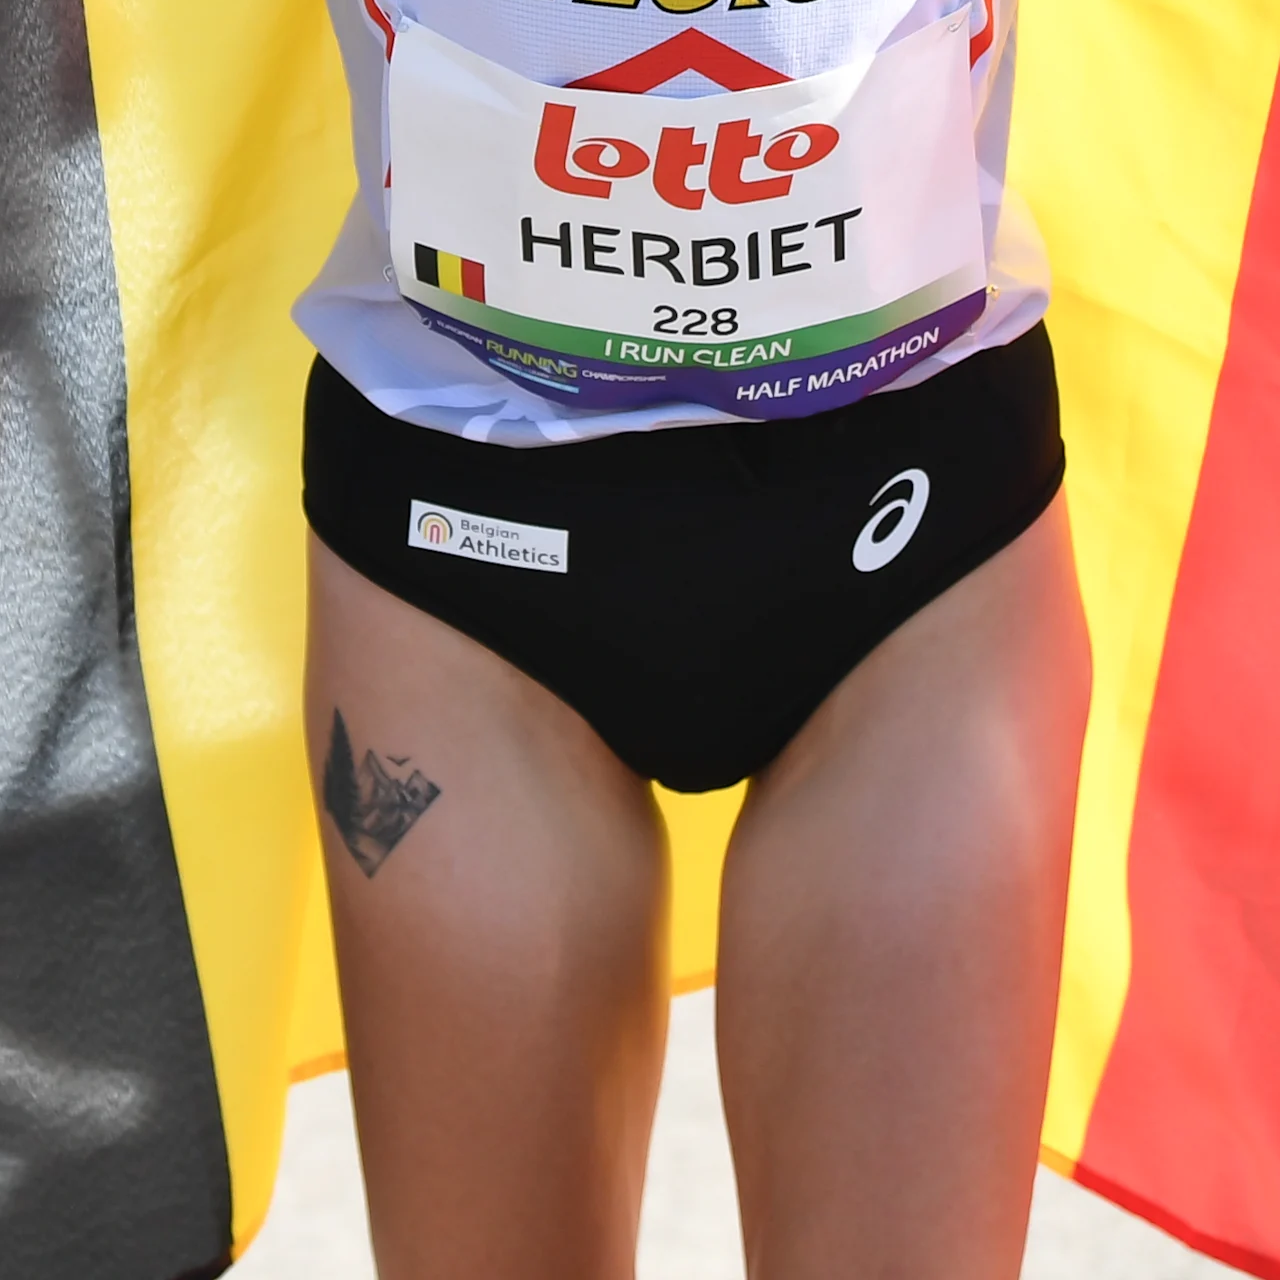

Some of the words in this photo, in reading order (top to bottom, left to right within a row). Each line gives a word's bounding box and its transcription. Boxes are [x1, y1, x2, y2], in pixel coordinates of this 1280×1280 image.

[520, 207, 862, 287] HERBIET
[652, 305, 739, 337] 228
[486, 338, 579, 379] RUNNING
[604, 338, 613, 357] I
[620, 340, 685, 365] RUN
[692, 338, 792, 368] CLEAN
[735, 376, 803, 402] HALF
[807, 326, 940, 393] MARATHON
[460, 518, 520, 540] Belgian
[458, 535, 561, 567] Athletics
